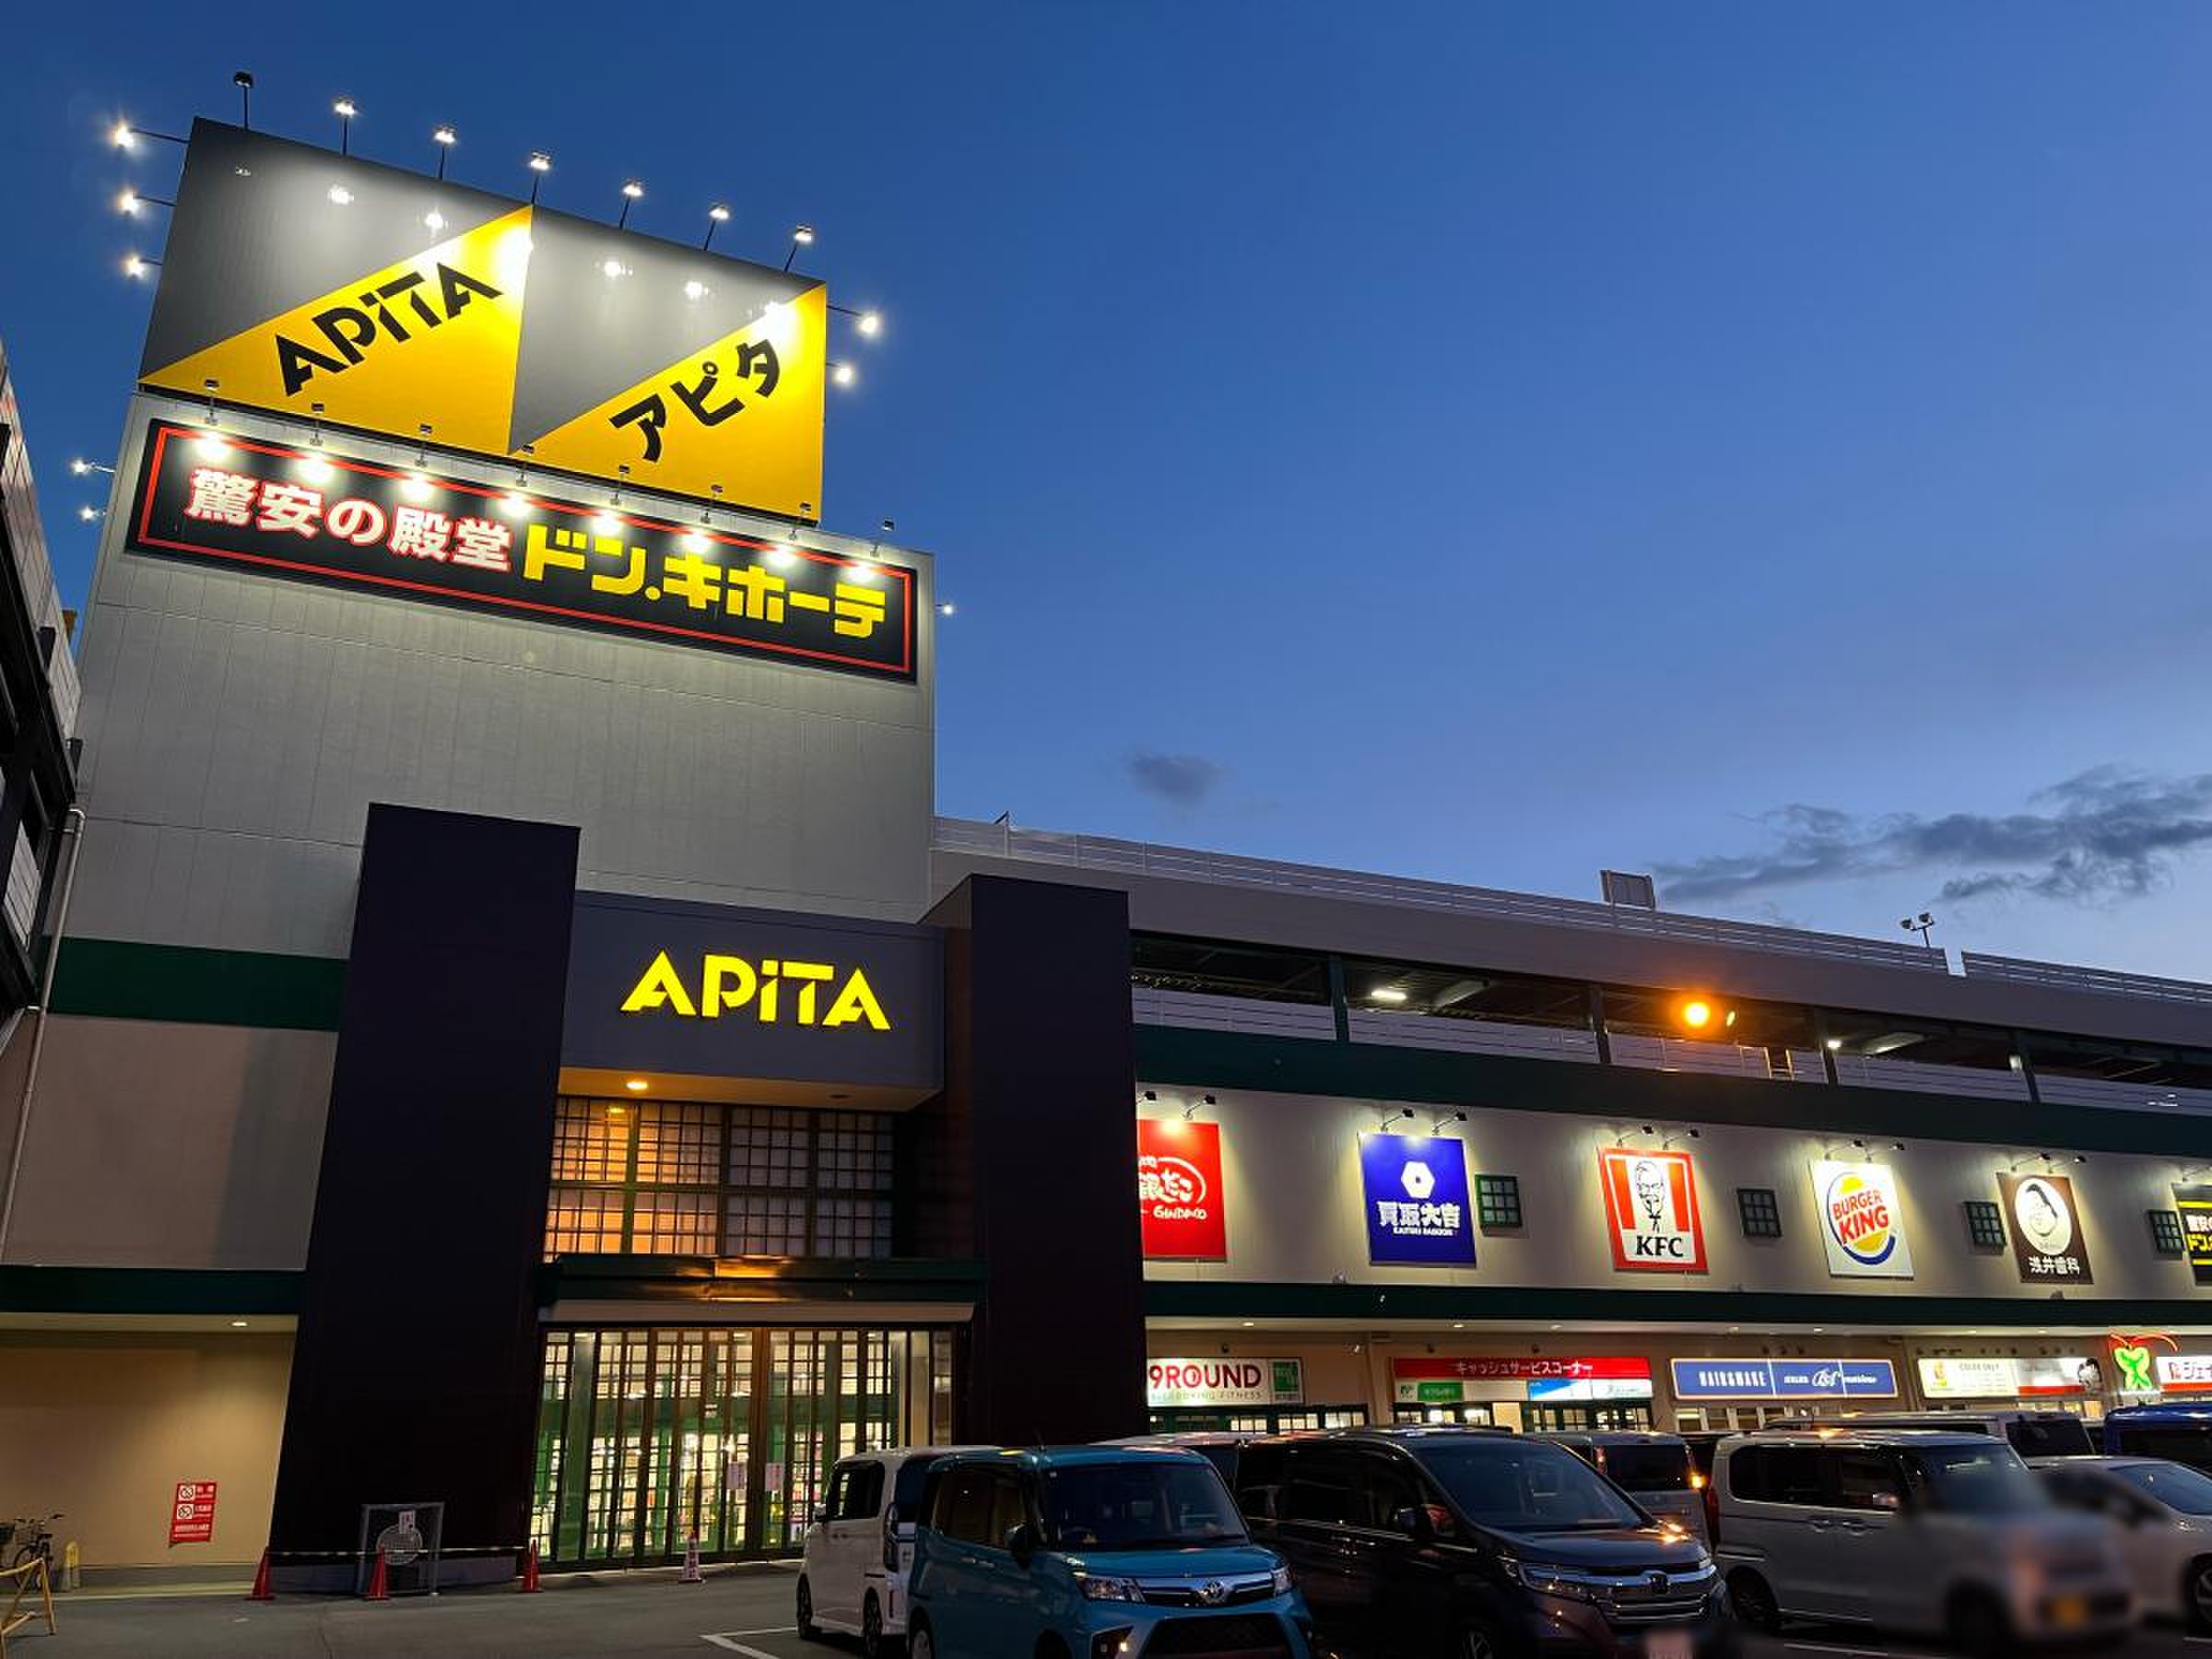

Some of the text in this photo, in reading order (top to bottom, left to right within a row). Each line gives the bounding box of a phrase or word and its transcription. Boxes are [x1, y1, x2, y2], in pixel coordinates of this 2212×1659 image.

[607, 338, 780, 463] アピタ
[185, 468, 512, 572] 驚安の殿堂
[1832, 1189, 1883, 1219] BURGER
[1839, 1205, 1889, 1244] KING
[1636, 1235, 1684, 1257] KFC
[1149, 1364, 1262, 1388] 9ROUND
